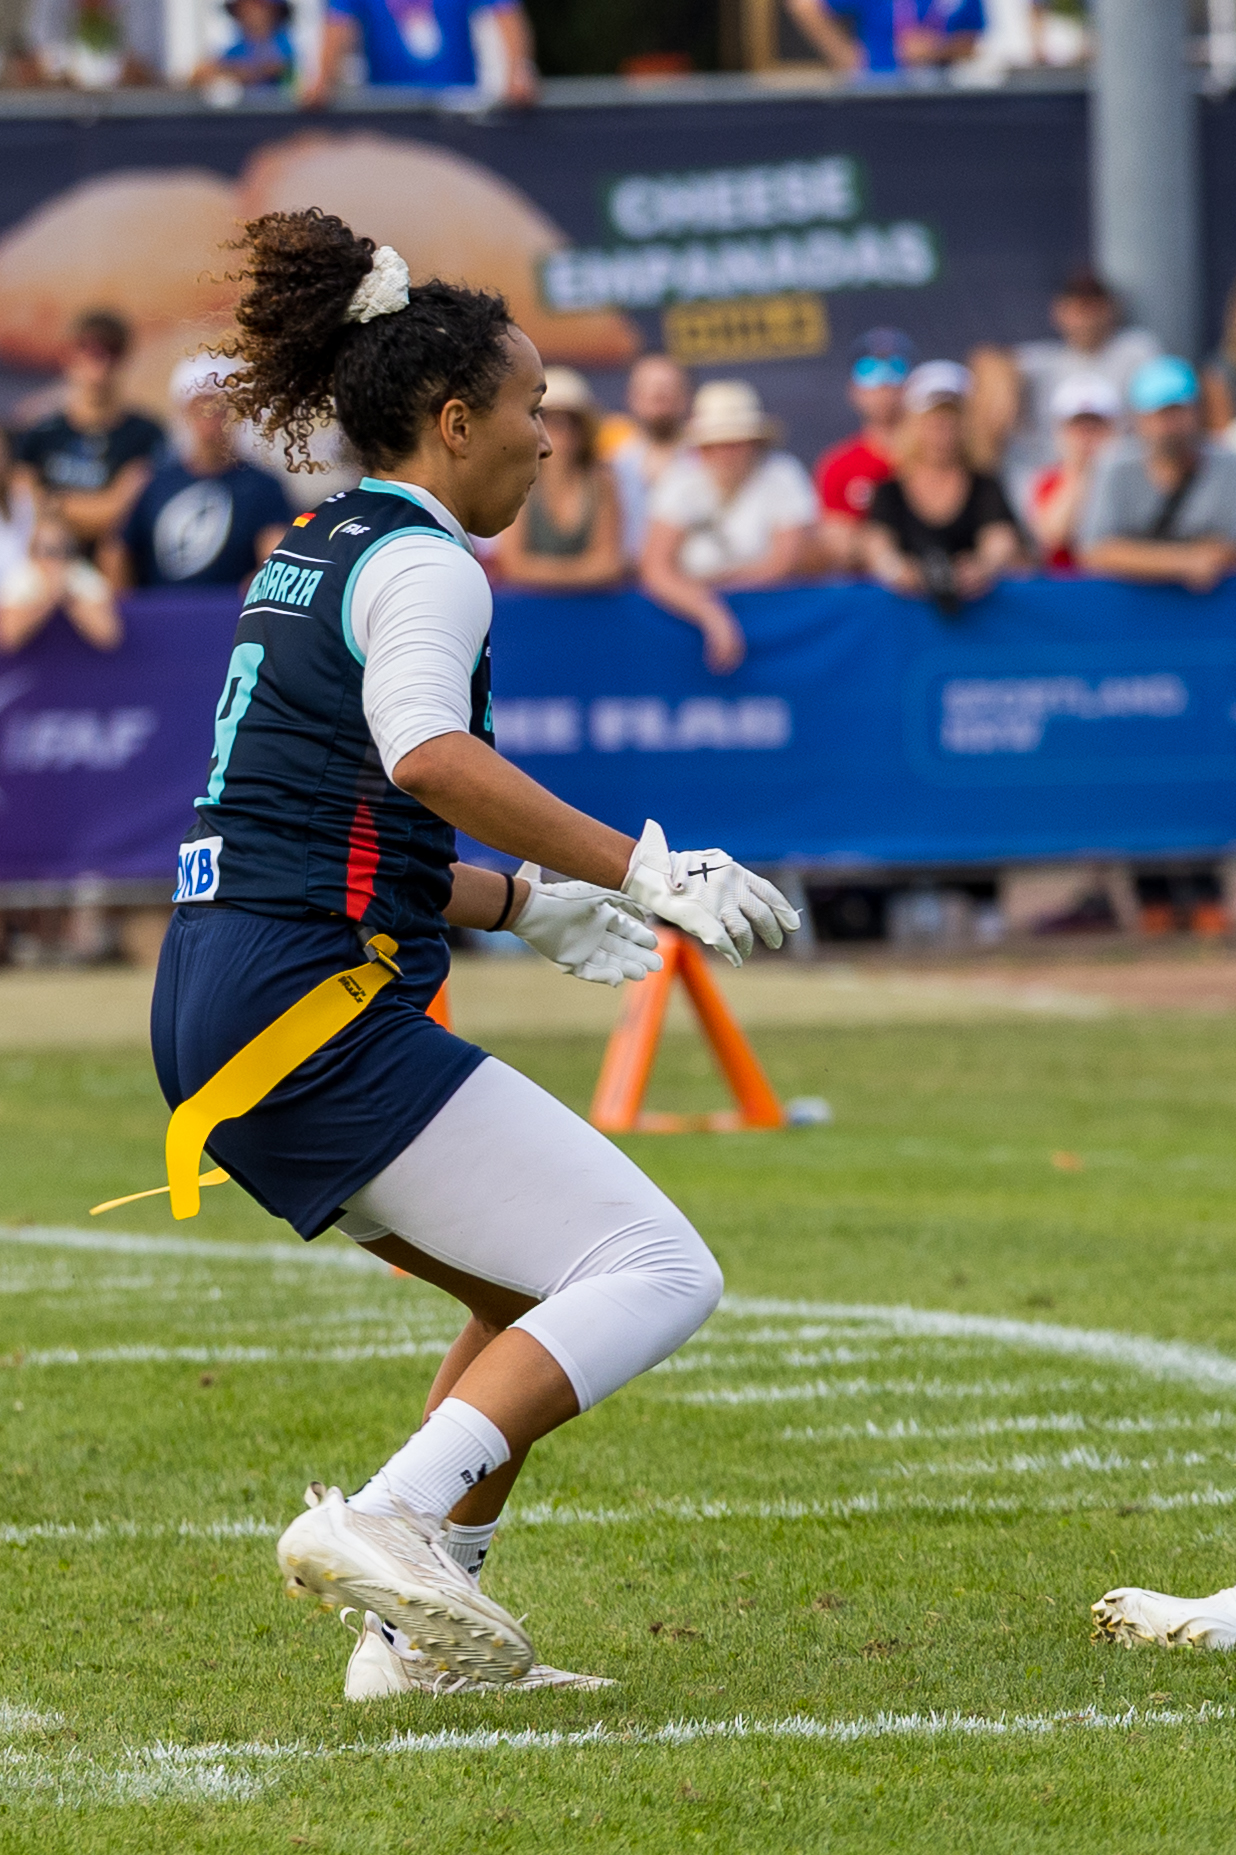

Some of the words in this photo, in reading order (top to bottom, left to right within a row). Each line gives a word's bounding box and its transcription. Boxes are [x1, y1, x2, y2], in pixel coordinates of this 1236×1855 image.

[612, 155, 857, 239] CHEESE
[544, 221, 937, 313] EMPANADAS
[588, 696, 791, 752] FLAG
